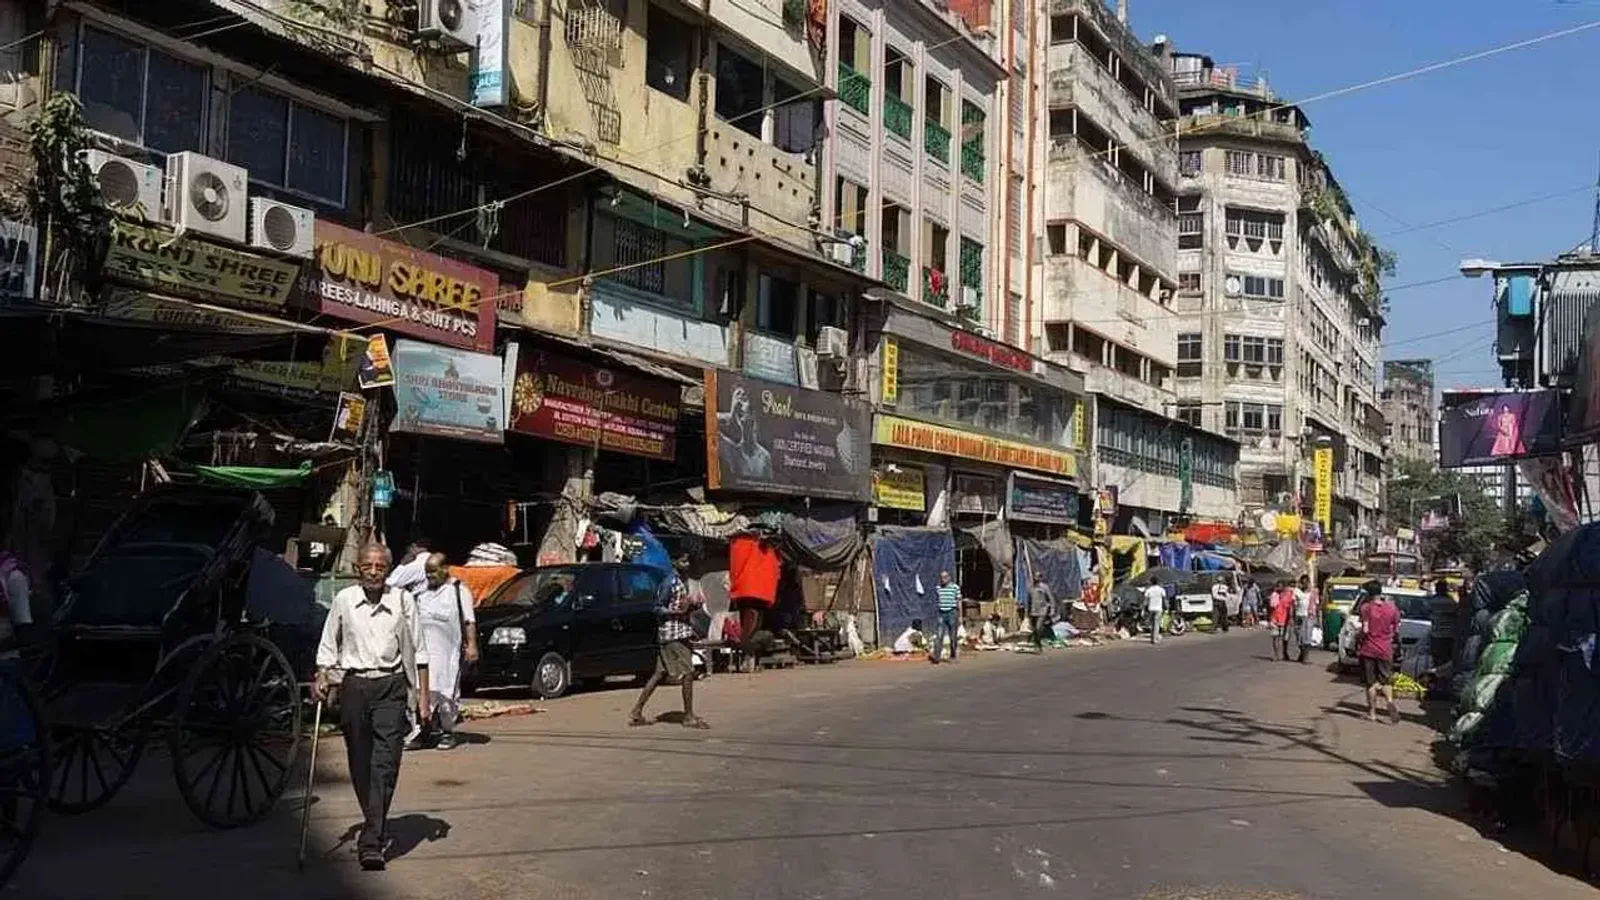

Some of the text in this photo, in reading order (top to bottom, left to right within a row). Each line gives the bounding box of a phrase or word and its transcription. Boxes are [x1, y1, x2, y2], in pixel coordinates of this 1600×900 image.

[204, 254, 290, 286] SHREE
[315, 239, 382, 294] UNJ
[411, 306, 421, 322] &
[423, 308, 451, 331] SUIT
[453, 318, 478, 337] PCS
